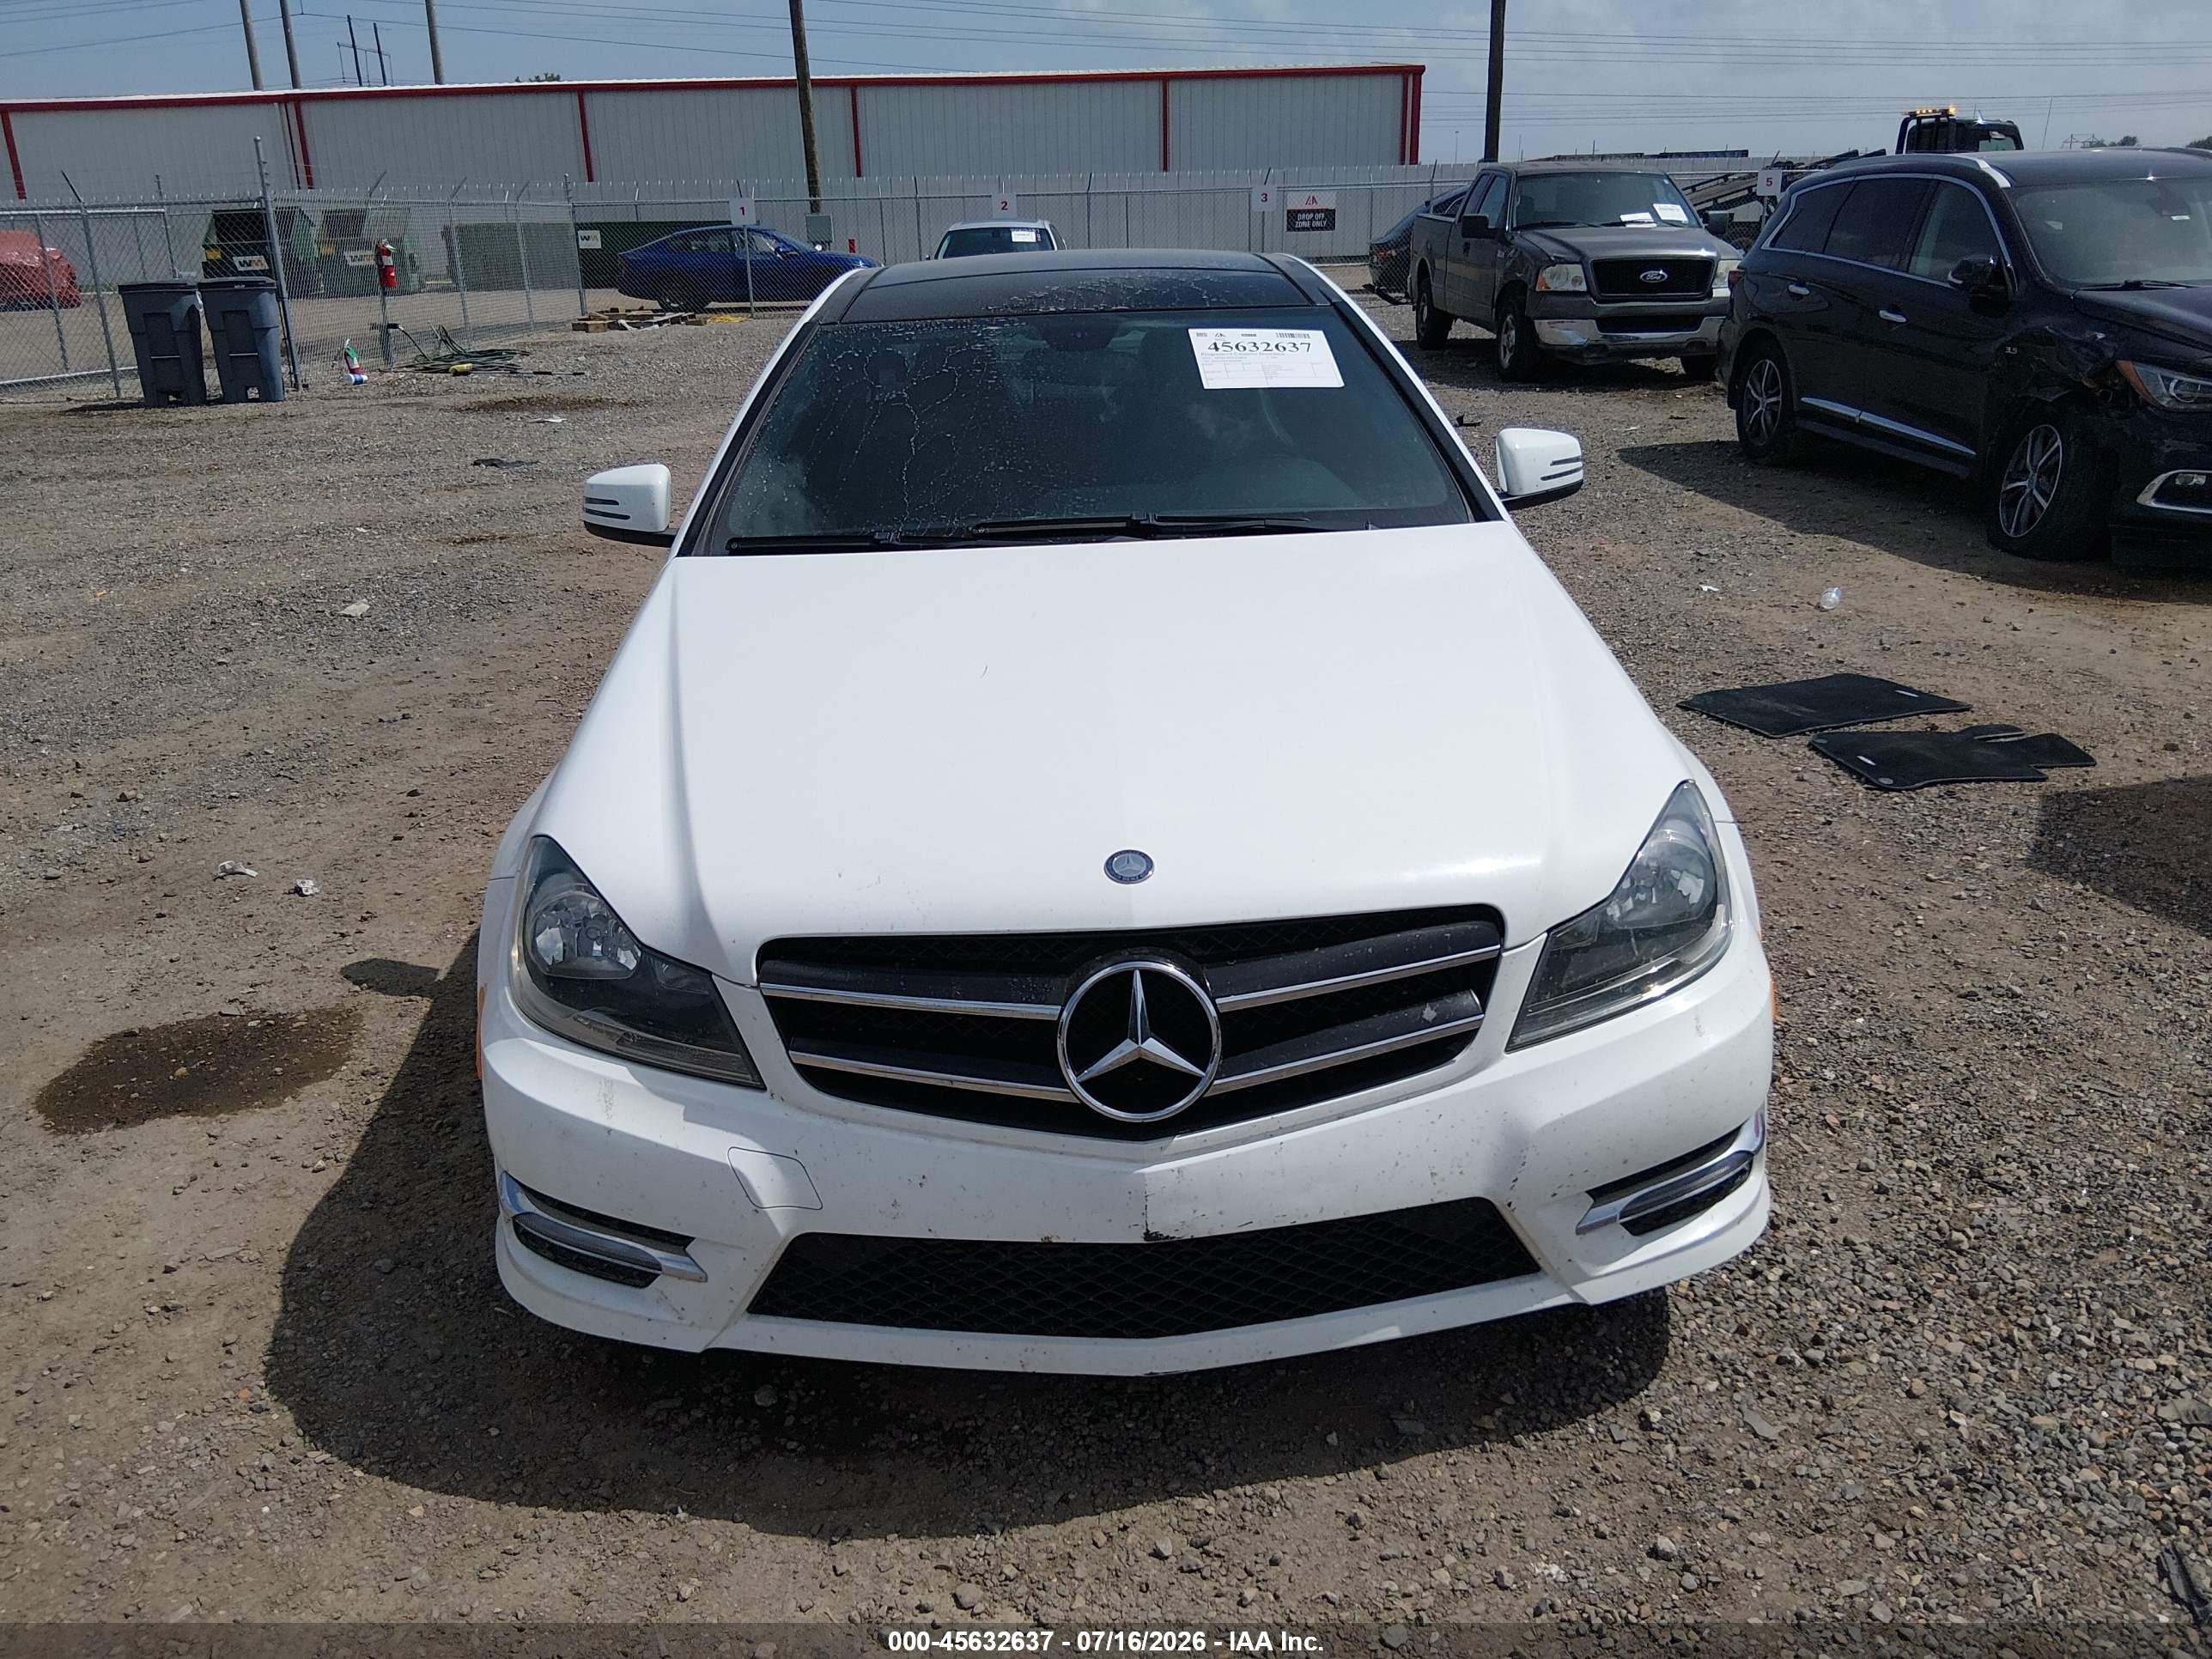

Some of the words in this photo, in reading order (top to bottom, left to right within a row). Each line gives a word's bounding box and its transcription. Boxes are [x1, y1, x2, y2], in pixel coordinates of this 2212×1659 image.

[1765, 177, 1773, 186] 5
[1261, 192, 1268, 203] 3
[1000, 200, 1008, 210] 2
[739, 206, 745, 216] 1
[238, 259, 264, 268] WM
[1207, 342, 1311, 353] 45632637
